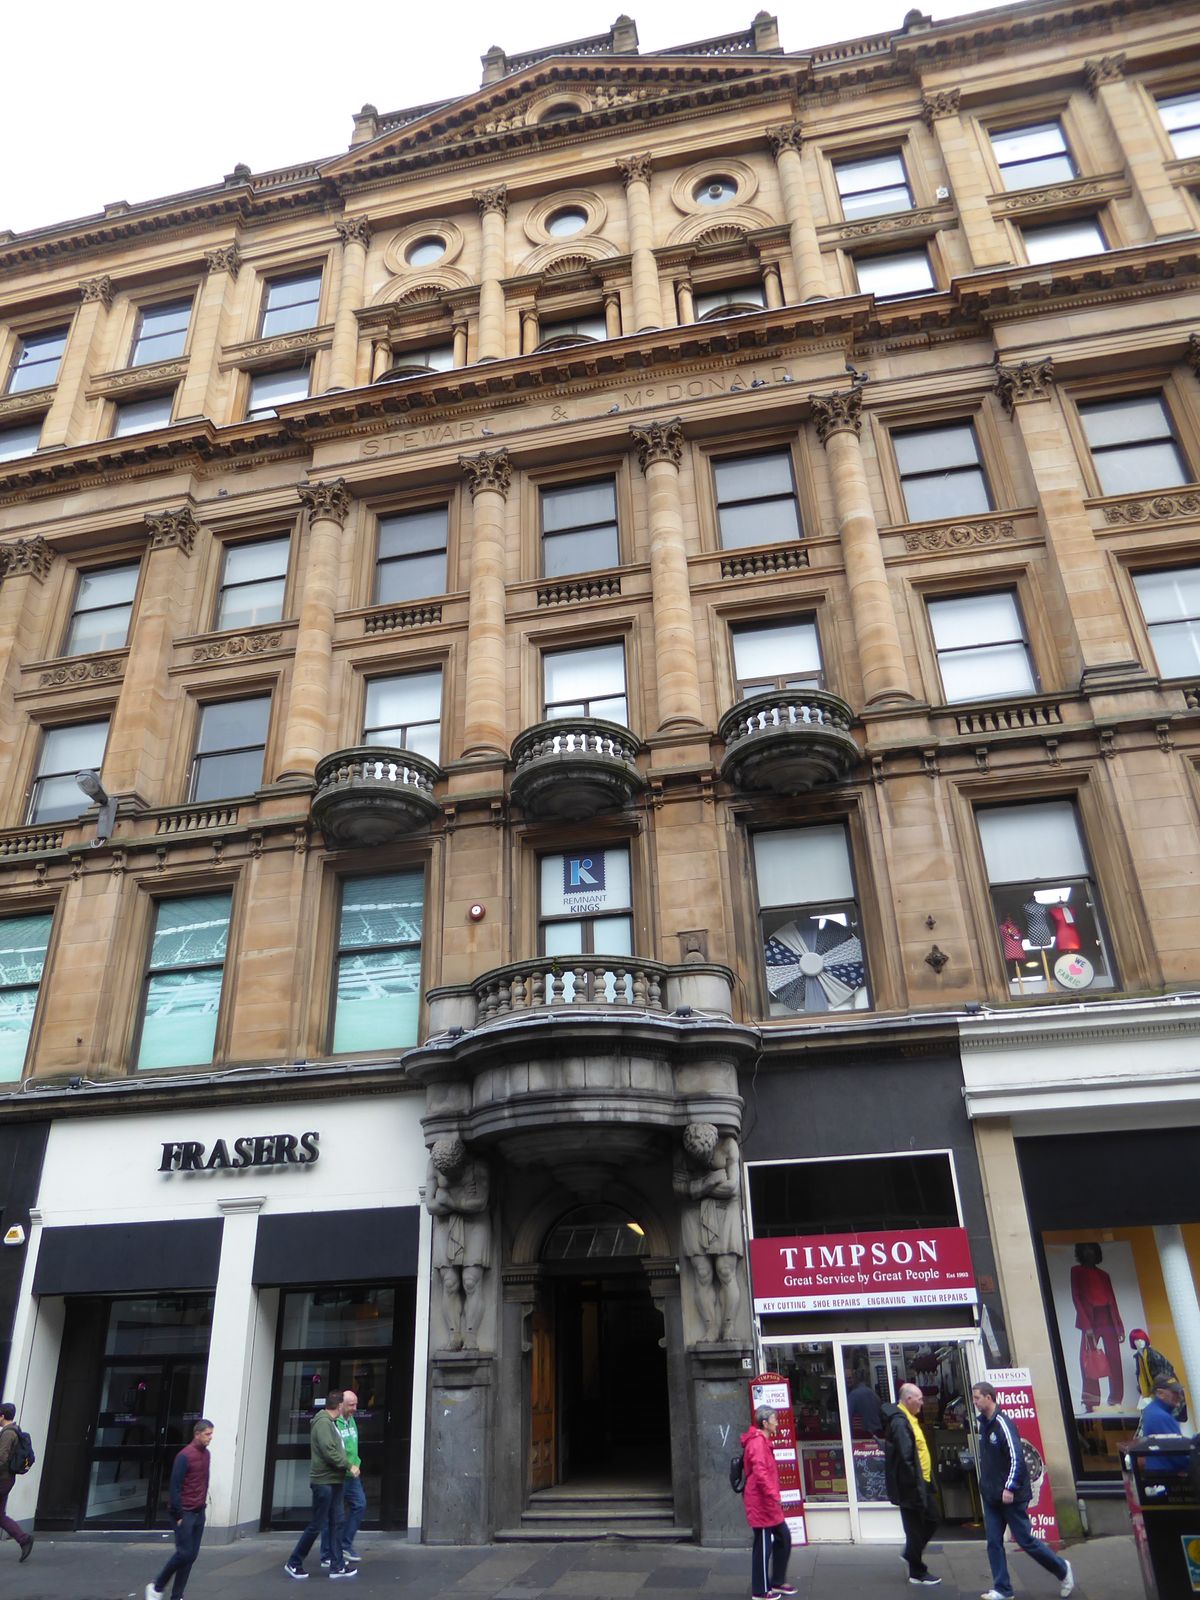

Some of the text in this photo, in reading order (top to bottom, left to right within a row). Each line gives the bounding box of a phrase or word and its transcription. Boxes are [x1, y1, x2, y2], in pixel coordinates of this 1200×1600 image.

[363, 417, 495, 455] STEWART
[551, 405, 569, 422] &
[563, 894, 608, 906] REMNANT
[570, 902, 601, 914] KINGS
[1074, 956, 1087, 969] WE
[157, 1131, 320, 1172] FRASERS
[779, 1239, 939, 1271] TIMPSON
[783, 1268, 940, 1287] Great Service by Great People
[763, 1293, 969, 1311] KEY CUTTING SHOE REPAIRS ENGRAVING WATCH REPAIRS
[757, 1374, 781, 1382] TIMPSON
[989, 1371, 1027, 1380] TIMPSON
[996, 1390, 1029, 1405] Watch
[1002, 1405, 1036, 1420] pairs
[1037, 1513, 1055, 1526] You
